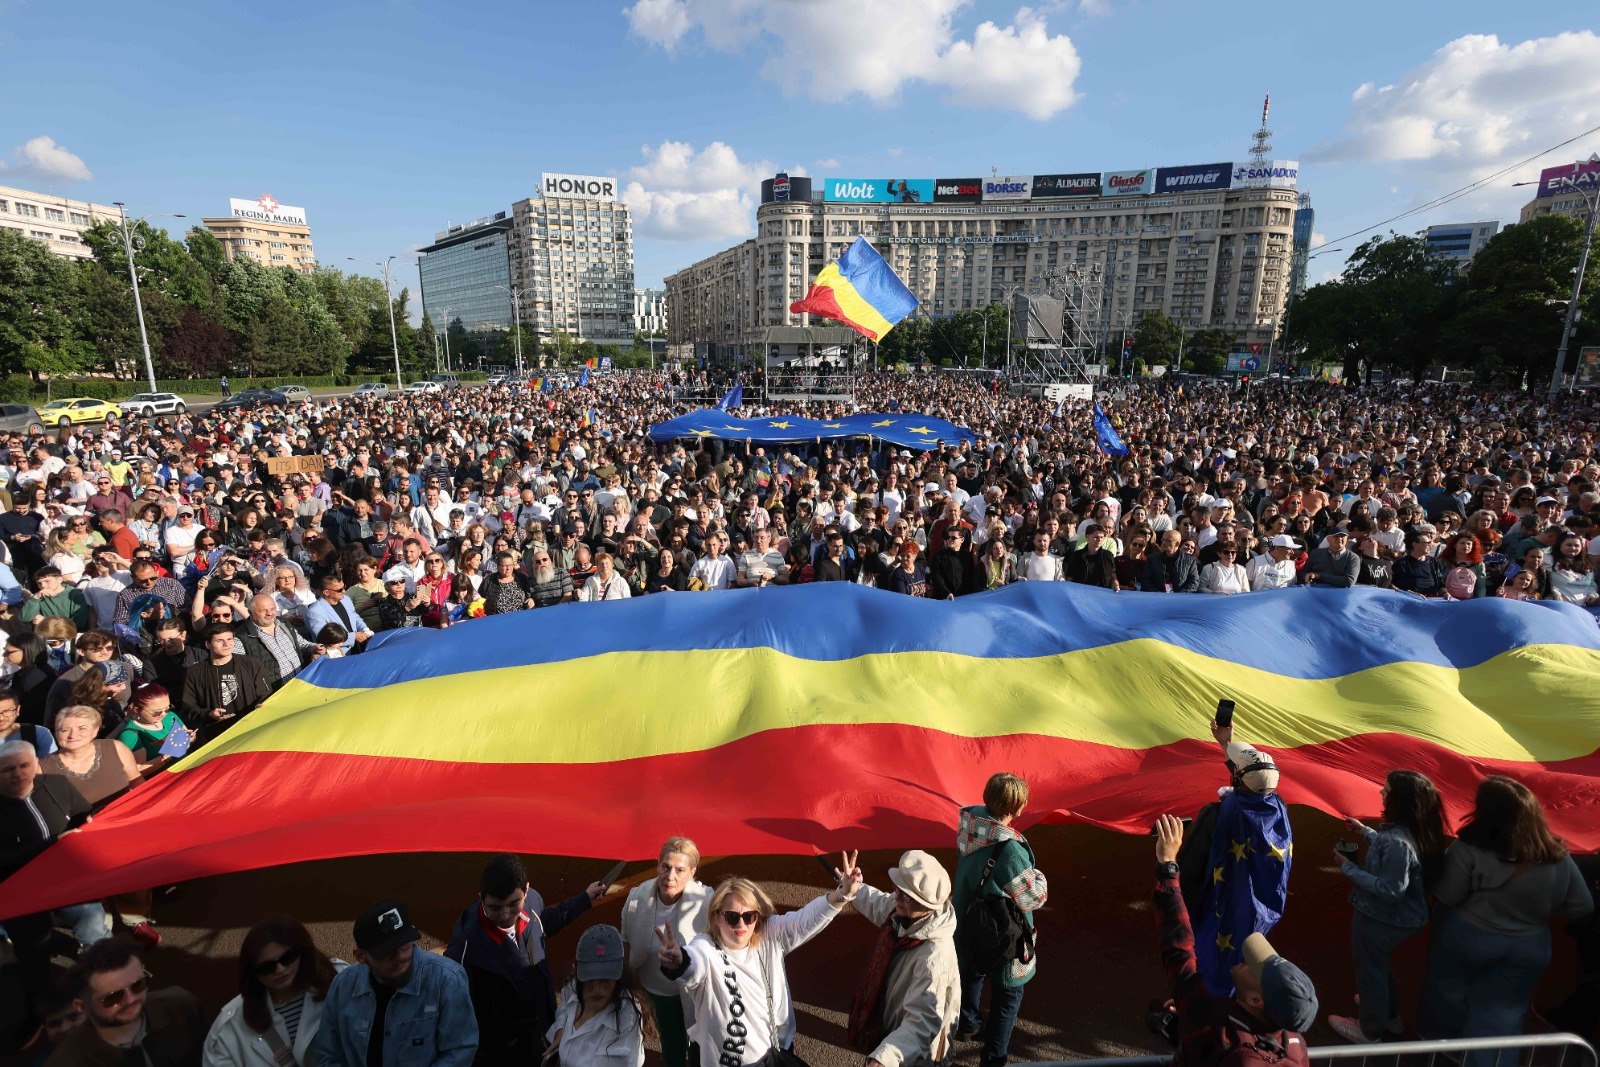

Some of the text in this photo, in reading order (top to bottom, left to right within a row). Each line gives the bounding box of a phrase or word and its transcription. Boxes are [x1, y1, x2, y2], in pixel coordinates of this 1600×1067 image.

[1165, 170, 1220, 187] winner
[1248, 167, 1298, 179] SANADOR
[546, 178, 614, 197] HONOR
[1055, 178, 1097, 188] ALBACHER
[1109, 173, 1145, 188] Giusto
[835, 182, 875, 198] Wolt
[938, 185, 980, 196] NetBet
[986, 182, 1028, 194] BORSEC
[234, 208, 304, 224] REGINA MARIA
[275, 457, 323, 471] ITS DAN
